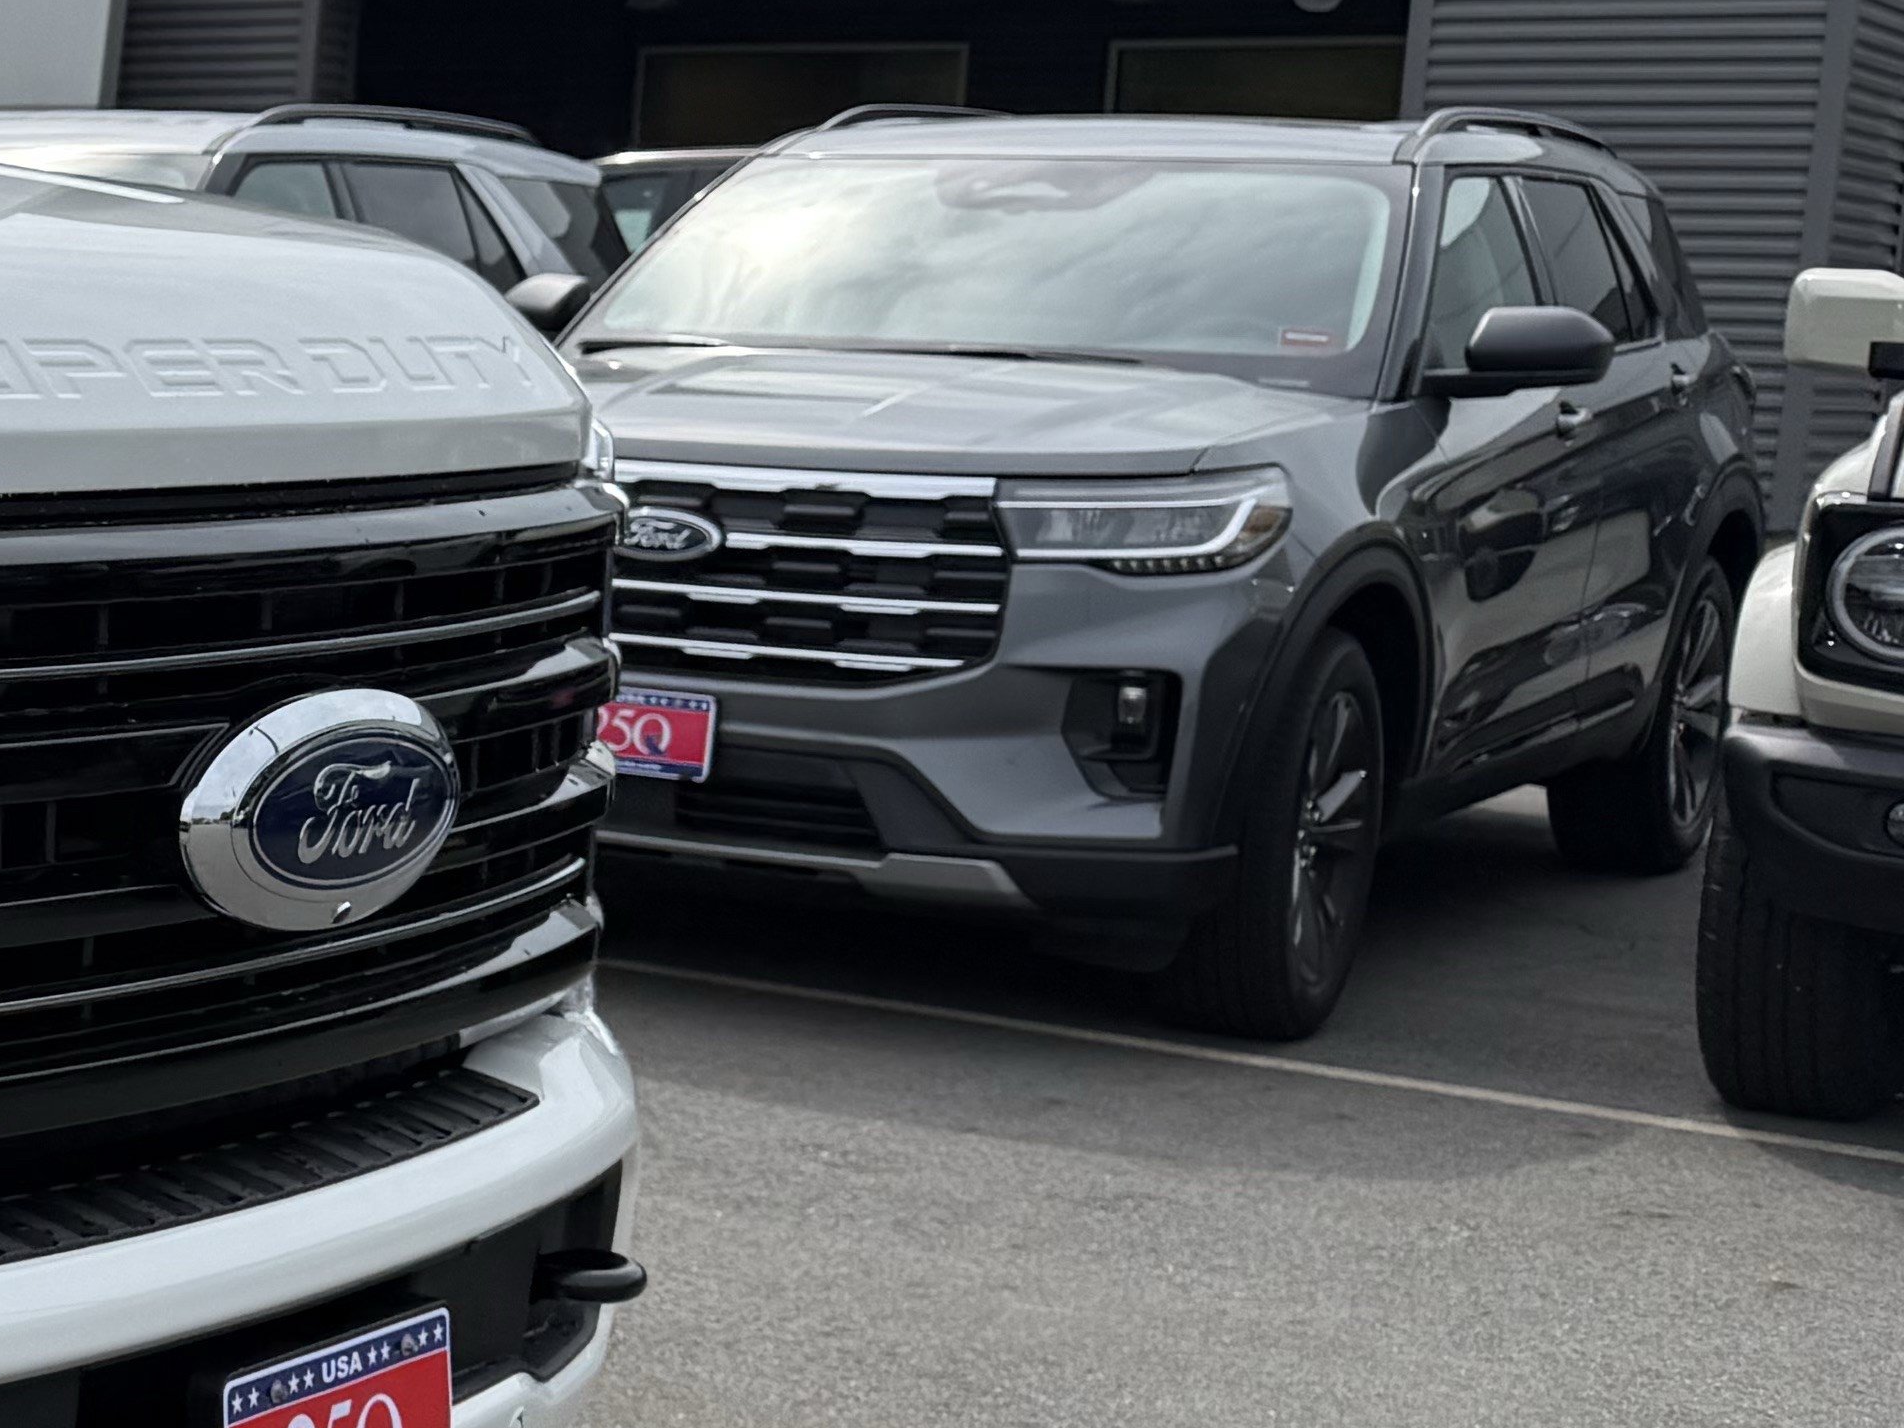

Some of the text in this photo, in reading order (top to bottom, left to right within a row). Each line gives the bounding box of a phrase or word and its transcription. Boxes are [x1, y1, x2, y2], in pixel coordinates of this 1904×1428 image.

[298, 335, 538, 398] DUTY
[623, 517, 692, 550] Ford
[297, 759, 421, 865] Ford
[321, 1350, 363, 1384] USA
